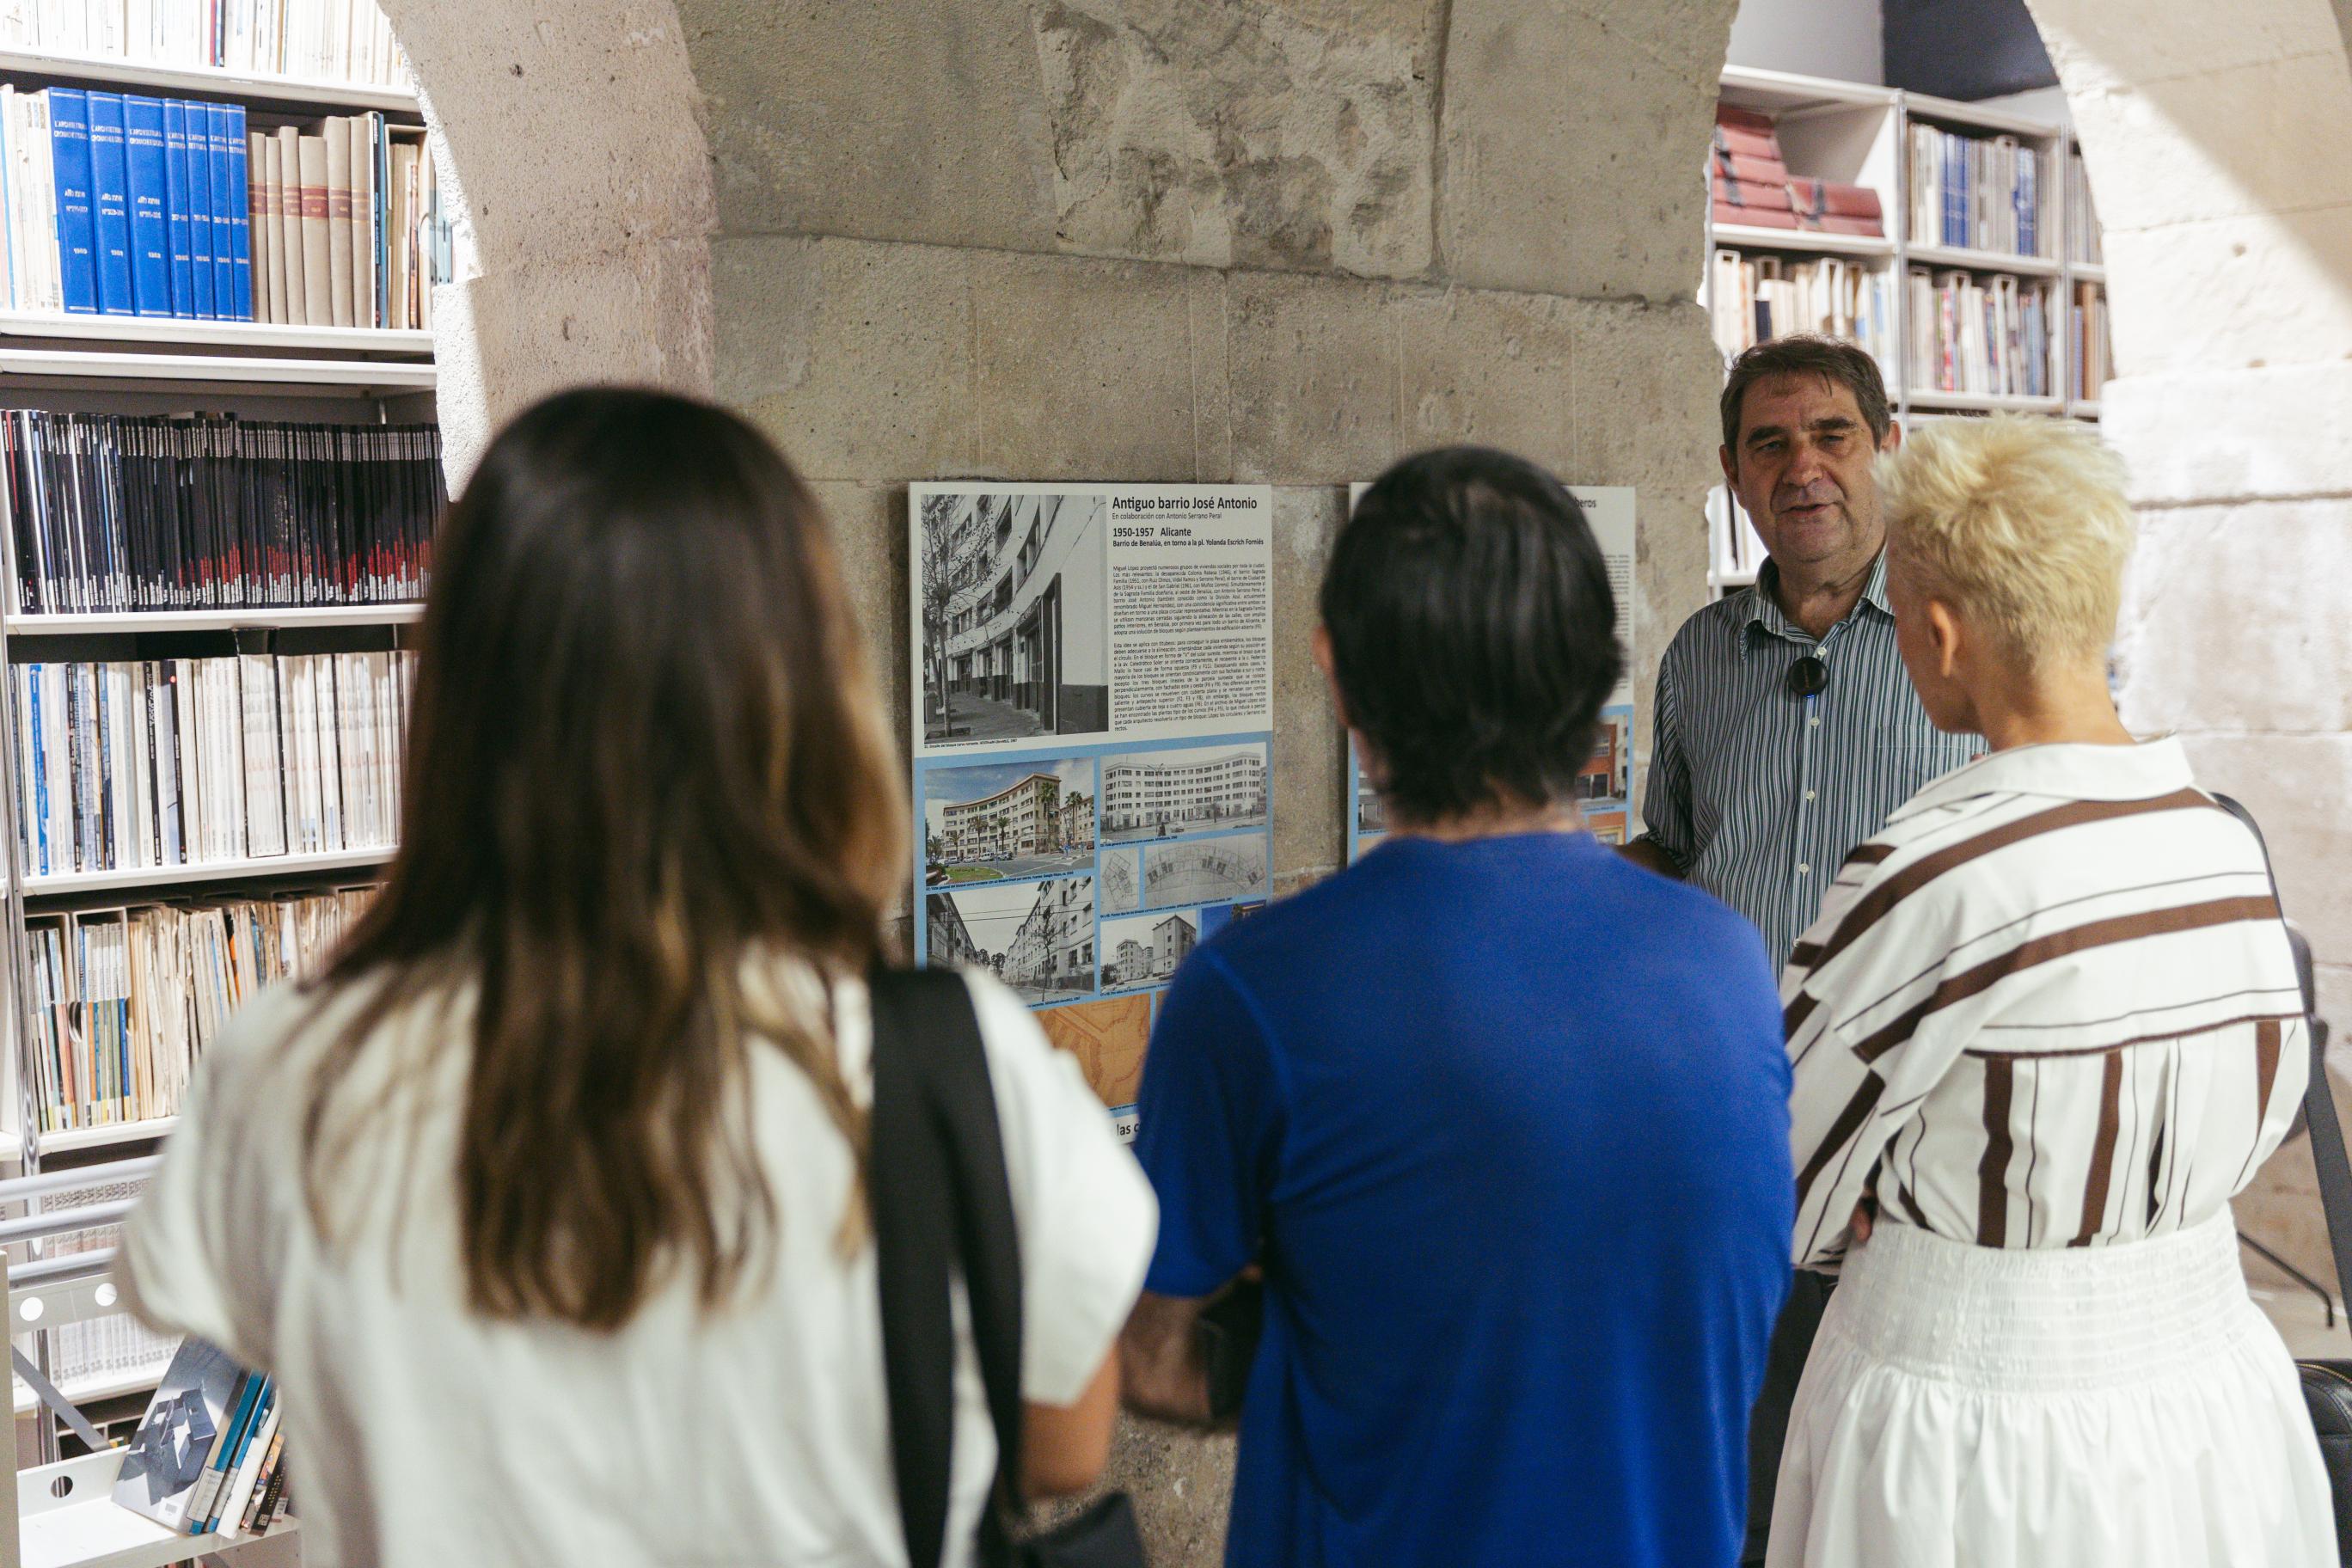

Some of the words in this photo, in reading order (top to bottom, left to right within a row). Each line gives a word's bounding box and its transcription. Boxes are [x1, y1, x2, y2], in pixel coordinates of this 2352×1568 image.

[1113, 497, 1155, 511] Antiguo
[1159, 497, 1189, 509] barrio
[1192, 496, 1214, 509] José
[1218, 497, 1257, 509] Antonio
[1113, 528, 1154, 537] 1950-1957
[1161, 527, 1191, 536] Alicante
[1117, 1124, 1131, 1136] las
